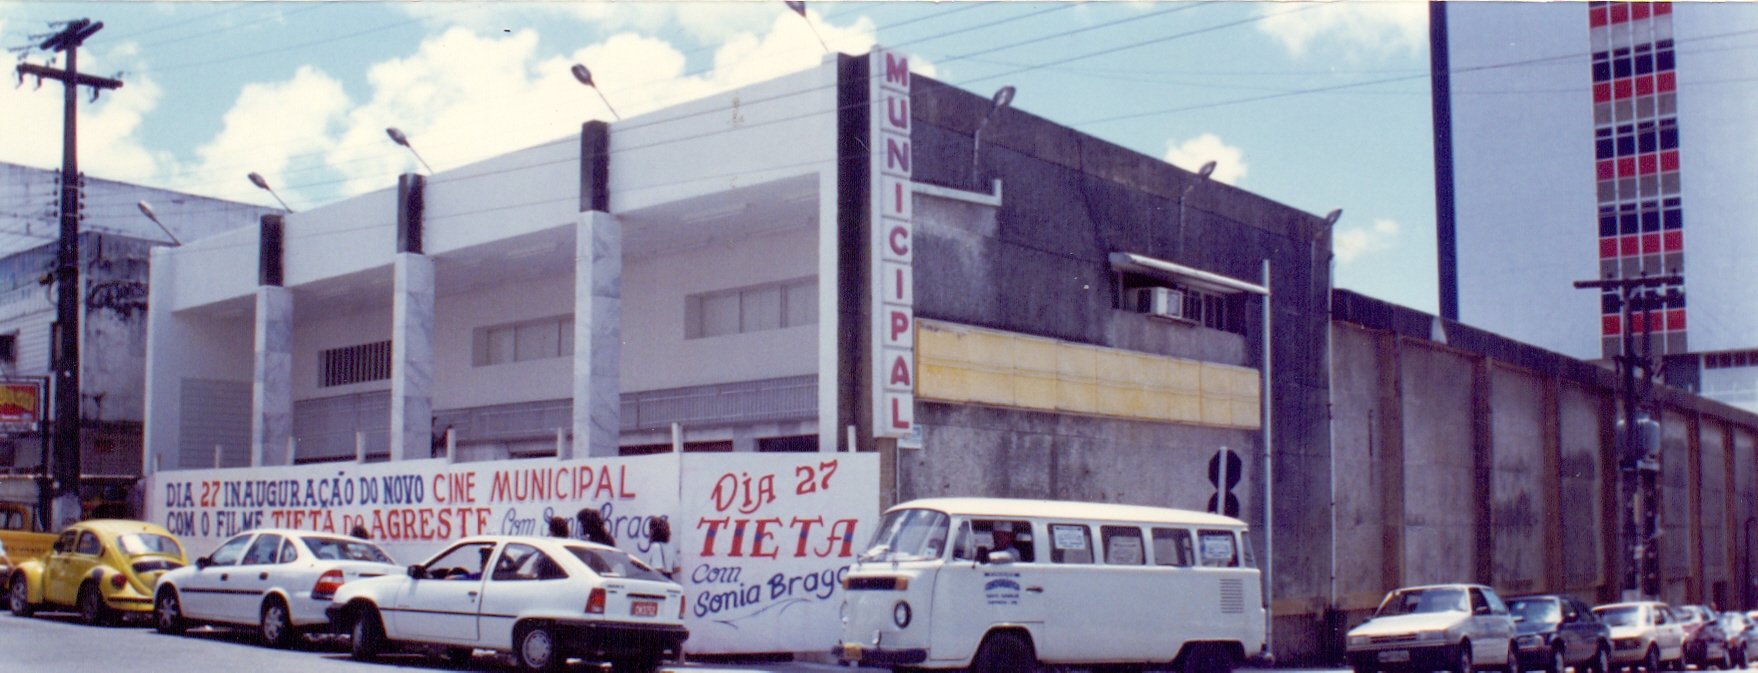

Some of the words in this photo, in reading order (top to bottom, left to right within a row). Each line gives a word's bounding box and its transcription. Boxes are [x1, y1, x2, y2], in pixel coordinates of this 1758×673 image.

[886, 52, 911, 430] MUNICIPAL
[166, 481, 195, 508] DIA
[200, 480, 222, 508] 27
[223, 471, 354, 510] INAUGURAÇÃO
[359, 476, 378, 506] DO
[382, 474, 426, 505] NOVO
[433, 471, 476, 504] CINE
[490, 464, 636, 503] MUNICIPAL
[794, 459, 839, 496] 27
[166, 511, 195, 537] COM
[200, 511, 210, 536] O
[215, 510, 264, 537] FILME
[271, 509, 335, 534] TIETA
[371, 507, 491, 540] AGRESTE
[501, 507, 536, 536] Com
[697, 515, 859, 560] TIETA
[692, 563, 742, 584] Com
[693, 582, 761, 618] Sonia
